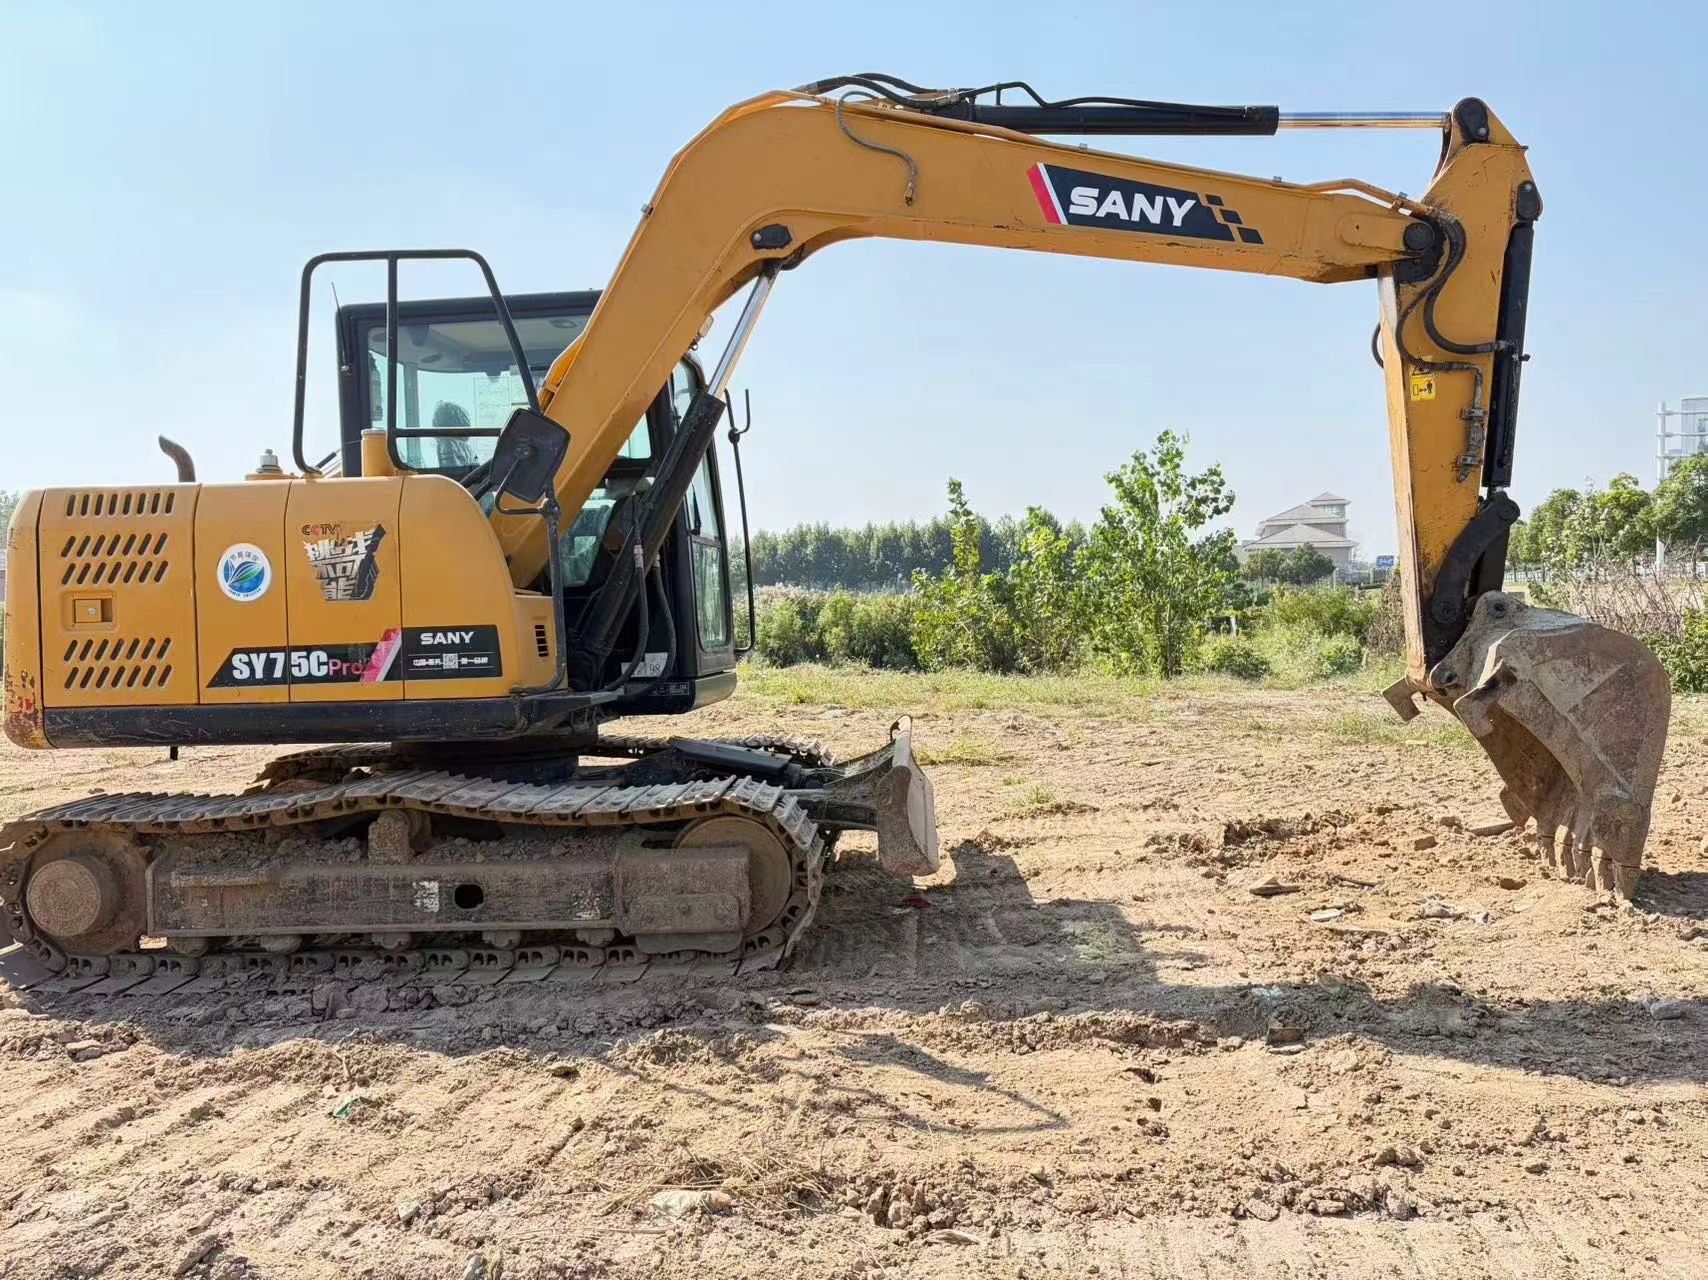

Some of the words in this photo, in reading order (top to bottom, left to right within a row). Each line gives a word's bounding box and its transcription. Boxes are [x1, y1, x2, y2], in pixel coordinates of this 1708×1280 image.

[1068, 186, 1196, 227] SANY
[302, 523, 337, 536] CCTV
[419, 631, 474, 645] SANY
